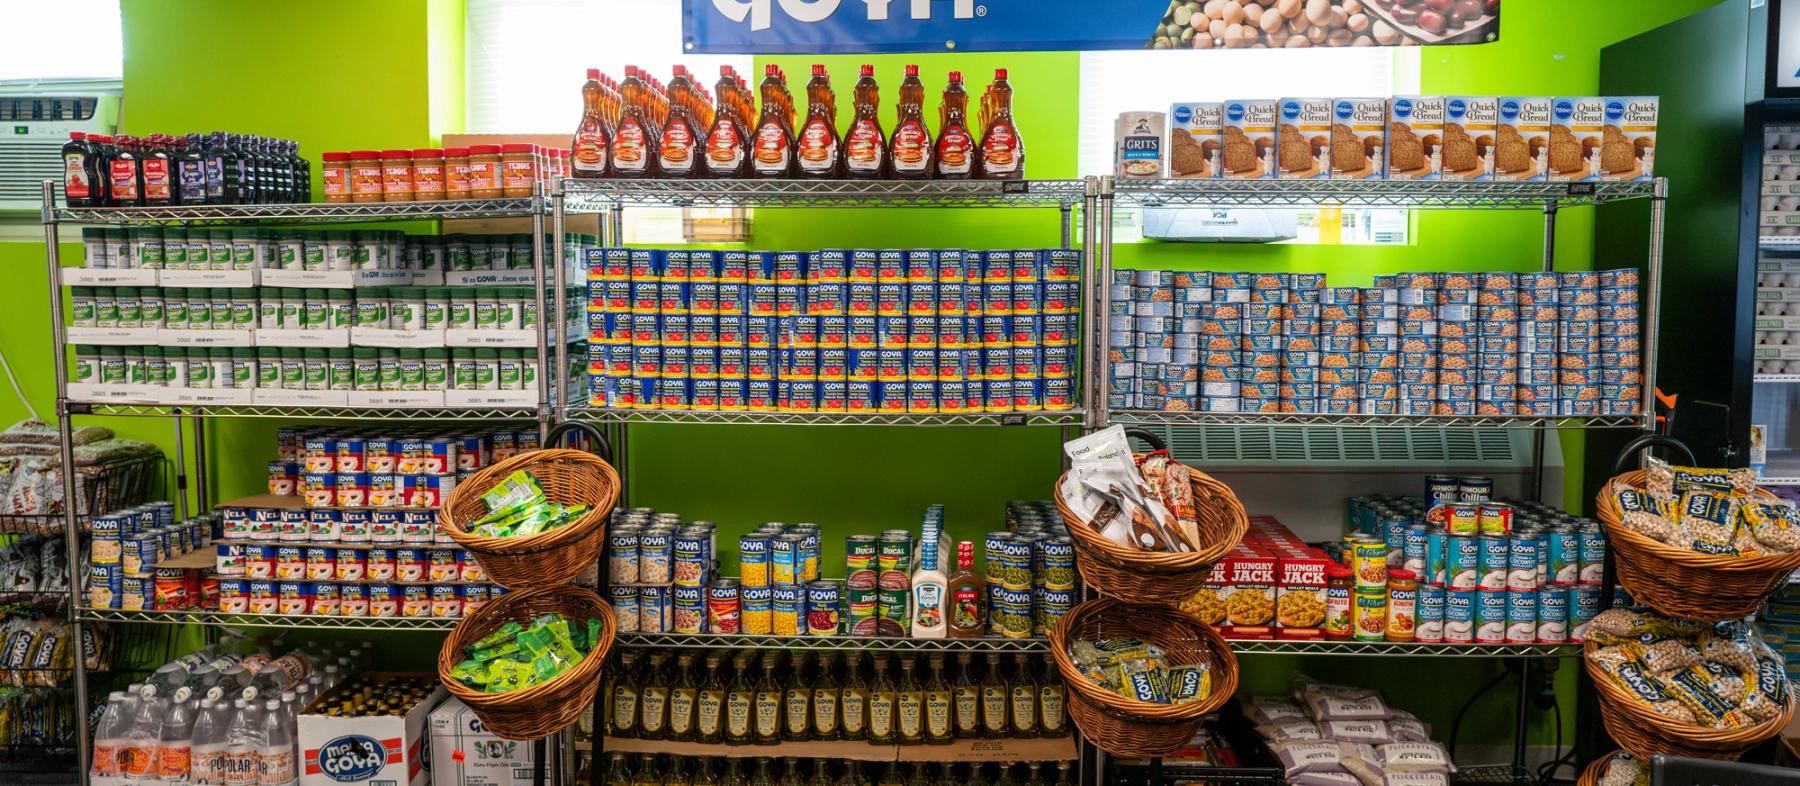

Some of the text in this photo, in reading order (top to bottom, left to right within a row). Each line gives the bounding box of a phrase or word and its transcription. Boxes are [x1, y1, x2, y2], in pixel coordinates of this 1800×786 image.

[1248, 104, 1274, 116] Quick
[1304, 104, 1330, 114] Quick
[1358, 104, 1382, 114] Quick
[1416, 102, 1442, 112] Quick
[1470, 102, 1496, 113] Quick
[1524, 103, 1549, 114] Quick
[1576, 103, 1602, 114] Quick
[1629, 103, 1656, 114] Quick
[1196, 108, 1220, 119] Quick
[1245, 114, 1274, 122] Bread
[1300, 112, 1330, 122] Bread
[1354, 112, 1382, 122] Bread
[1413, 110, 1442, 120] Bread
[1466, 112, 1496, 120] Bread
[1520, 112, 1548, 122] Bread
[1572, 112, 1602, 122] Bread
[1624, 112, 1654, 122] Bread
[1192, 116, 1220, 126] Bread
[1127, 140, 1157, 150] GRITS
[1072, 446, 1090, 456] Food
[1681, 472, 1727, 484] GOYA
[1460, 493, 1479, 502] Chili
[1690, 494, 1707, 516] GOYA
[224, 509, 246, 519] NELA
[281, 512, 304, 521] NELA
[342, 513, 366, 522] NELA
[372, 512, 396, 522] NELA
[405, 513, 430, 522] NELA
[92, 520, 118, 529] GOYA
[612, 537, 638, 546] GOYA
[641, 537, 666, 546] GOYA
[676, 541, 698, 551] GOYA
[740, 541, 764, 550] GOYA
[1004, 546, 1030, 555] GOYA
[1045, 546, 1072, 554] GOYA
[1234, 562, 1274, 570] HUNGRY
[157, 568, 184, 577] GOYA
[1232, 570, 1274, 582] JACK
[1282, 572, 1325, 584] JACK
[612, 586, 638, 595] GOYA
[676, 588, 698, 598] GOYA
[712, 588, 737, 598] GOYA
[744, 589, 771, 599] GOYA
[810, 591, 836, 600] GOYA
[1328, 589, 1348, 597] OYA
[1392, 590, 1415, 598] GOYA
[1003, 594, 1030, 604] GOYA
[1044, 593, 1068, 602] GOYA
[12, 634, 31, 667] GOYA
[39, 637, 55, 665] GOYA
[1762, 661, 1775, 693] GOYA
[1136, 674, 1152, 701] GOYA
[1184, 671, 1197, 695] GOYA
[1623, 667, 1659, 701] GOYA
[326, 741, 374, 757] MAA
[224, 759, 250, 772] POLAR
[326, 753, 381, 773] GOYA
